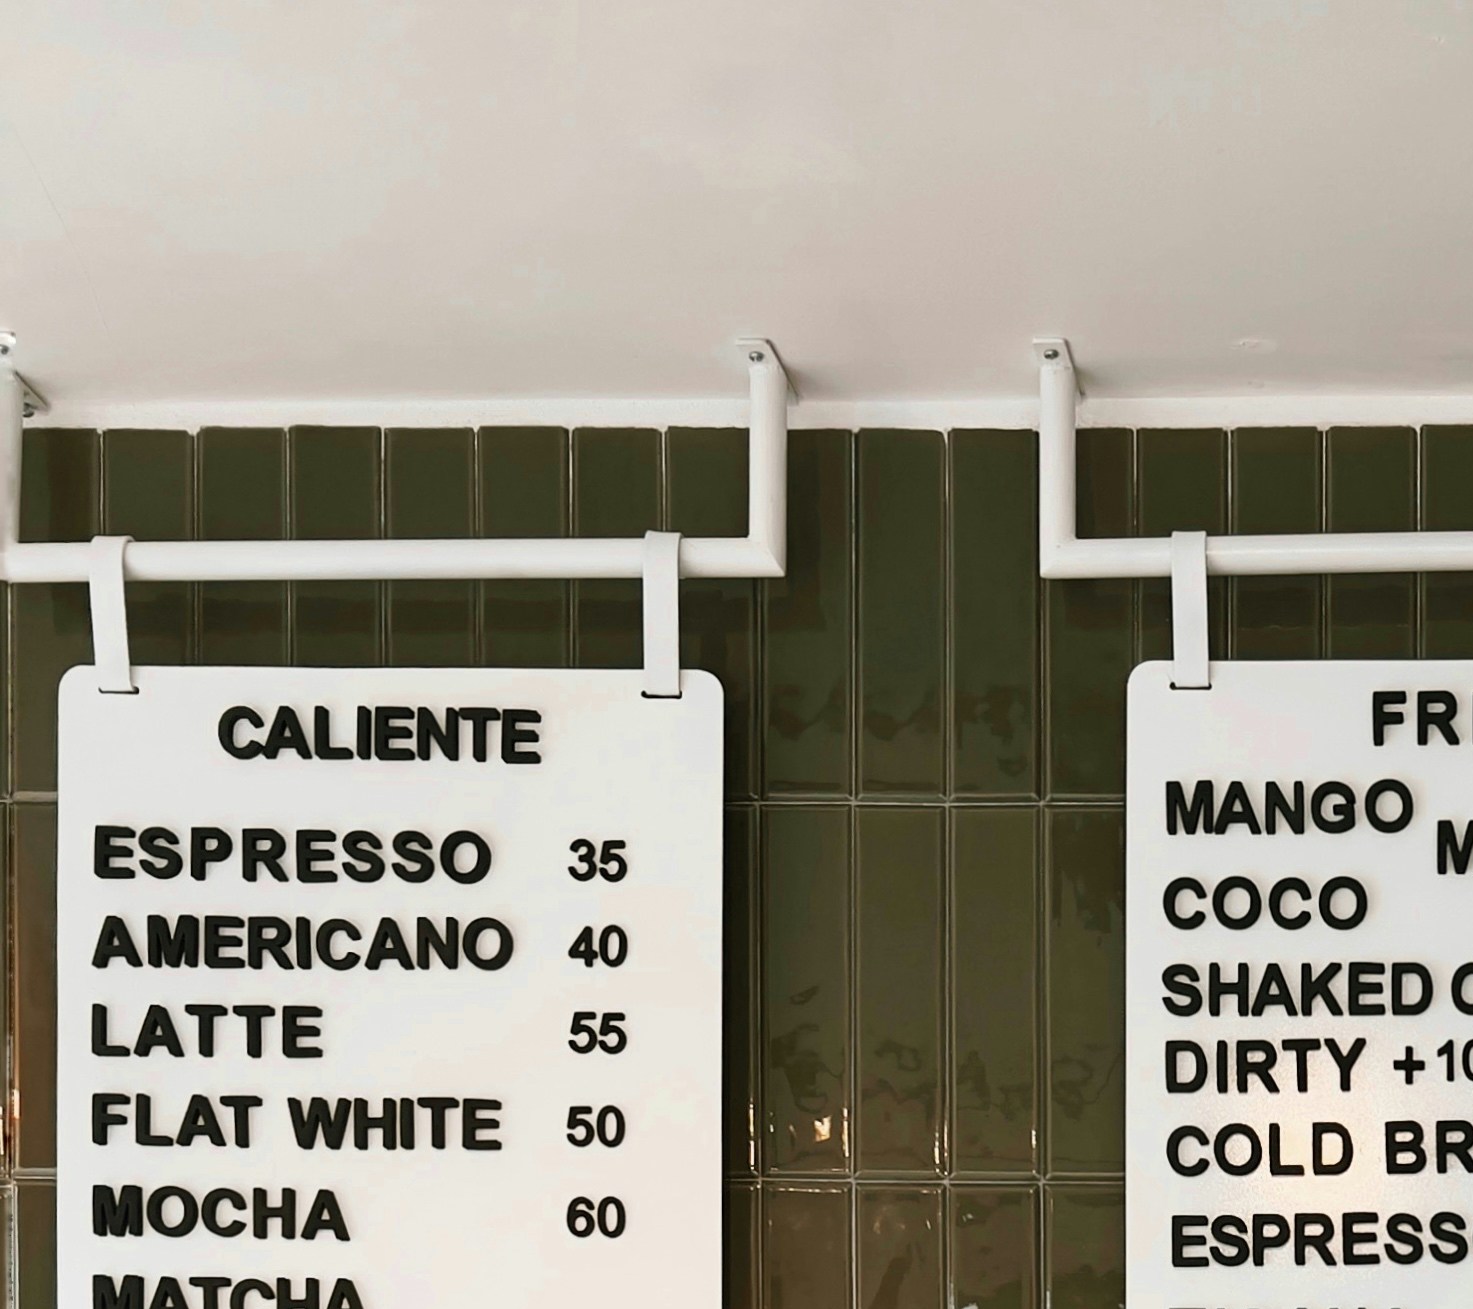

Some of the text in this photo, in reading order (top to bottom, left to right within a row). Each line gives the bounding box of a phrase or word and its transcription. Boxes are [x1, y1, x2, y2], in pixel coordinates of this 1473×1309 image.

[218, 706, 541, 764] CALIENTE
[1166, 779, 1413, 835] MANGO
[94, 826, 627, 884] ESPRESSO 35
[1163, 876, 1367, 930] COCO
[92, 915, 627, 970] AMERICANO 40
[1162, 962, 1433, 1016] SHAKED
[92, 1004, 627, 1058] LATTE 55
[1165, 1038, 1366, 1093] DIRTY
[92, 1093, 625, 1150] FLAT WHITE 50
[1167, 1122, 1353, 1177] COLD
[93, 1185, 625, 1241] MOCHA 60
